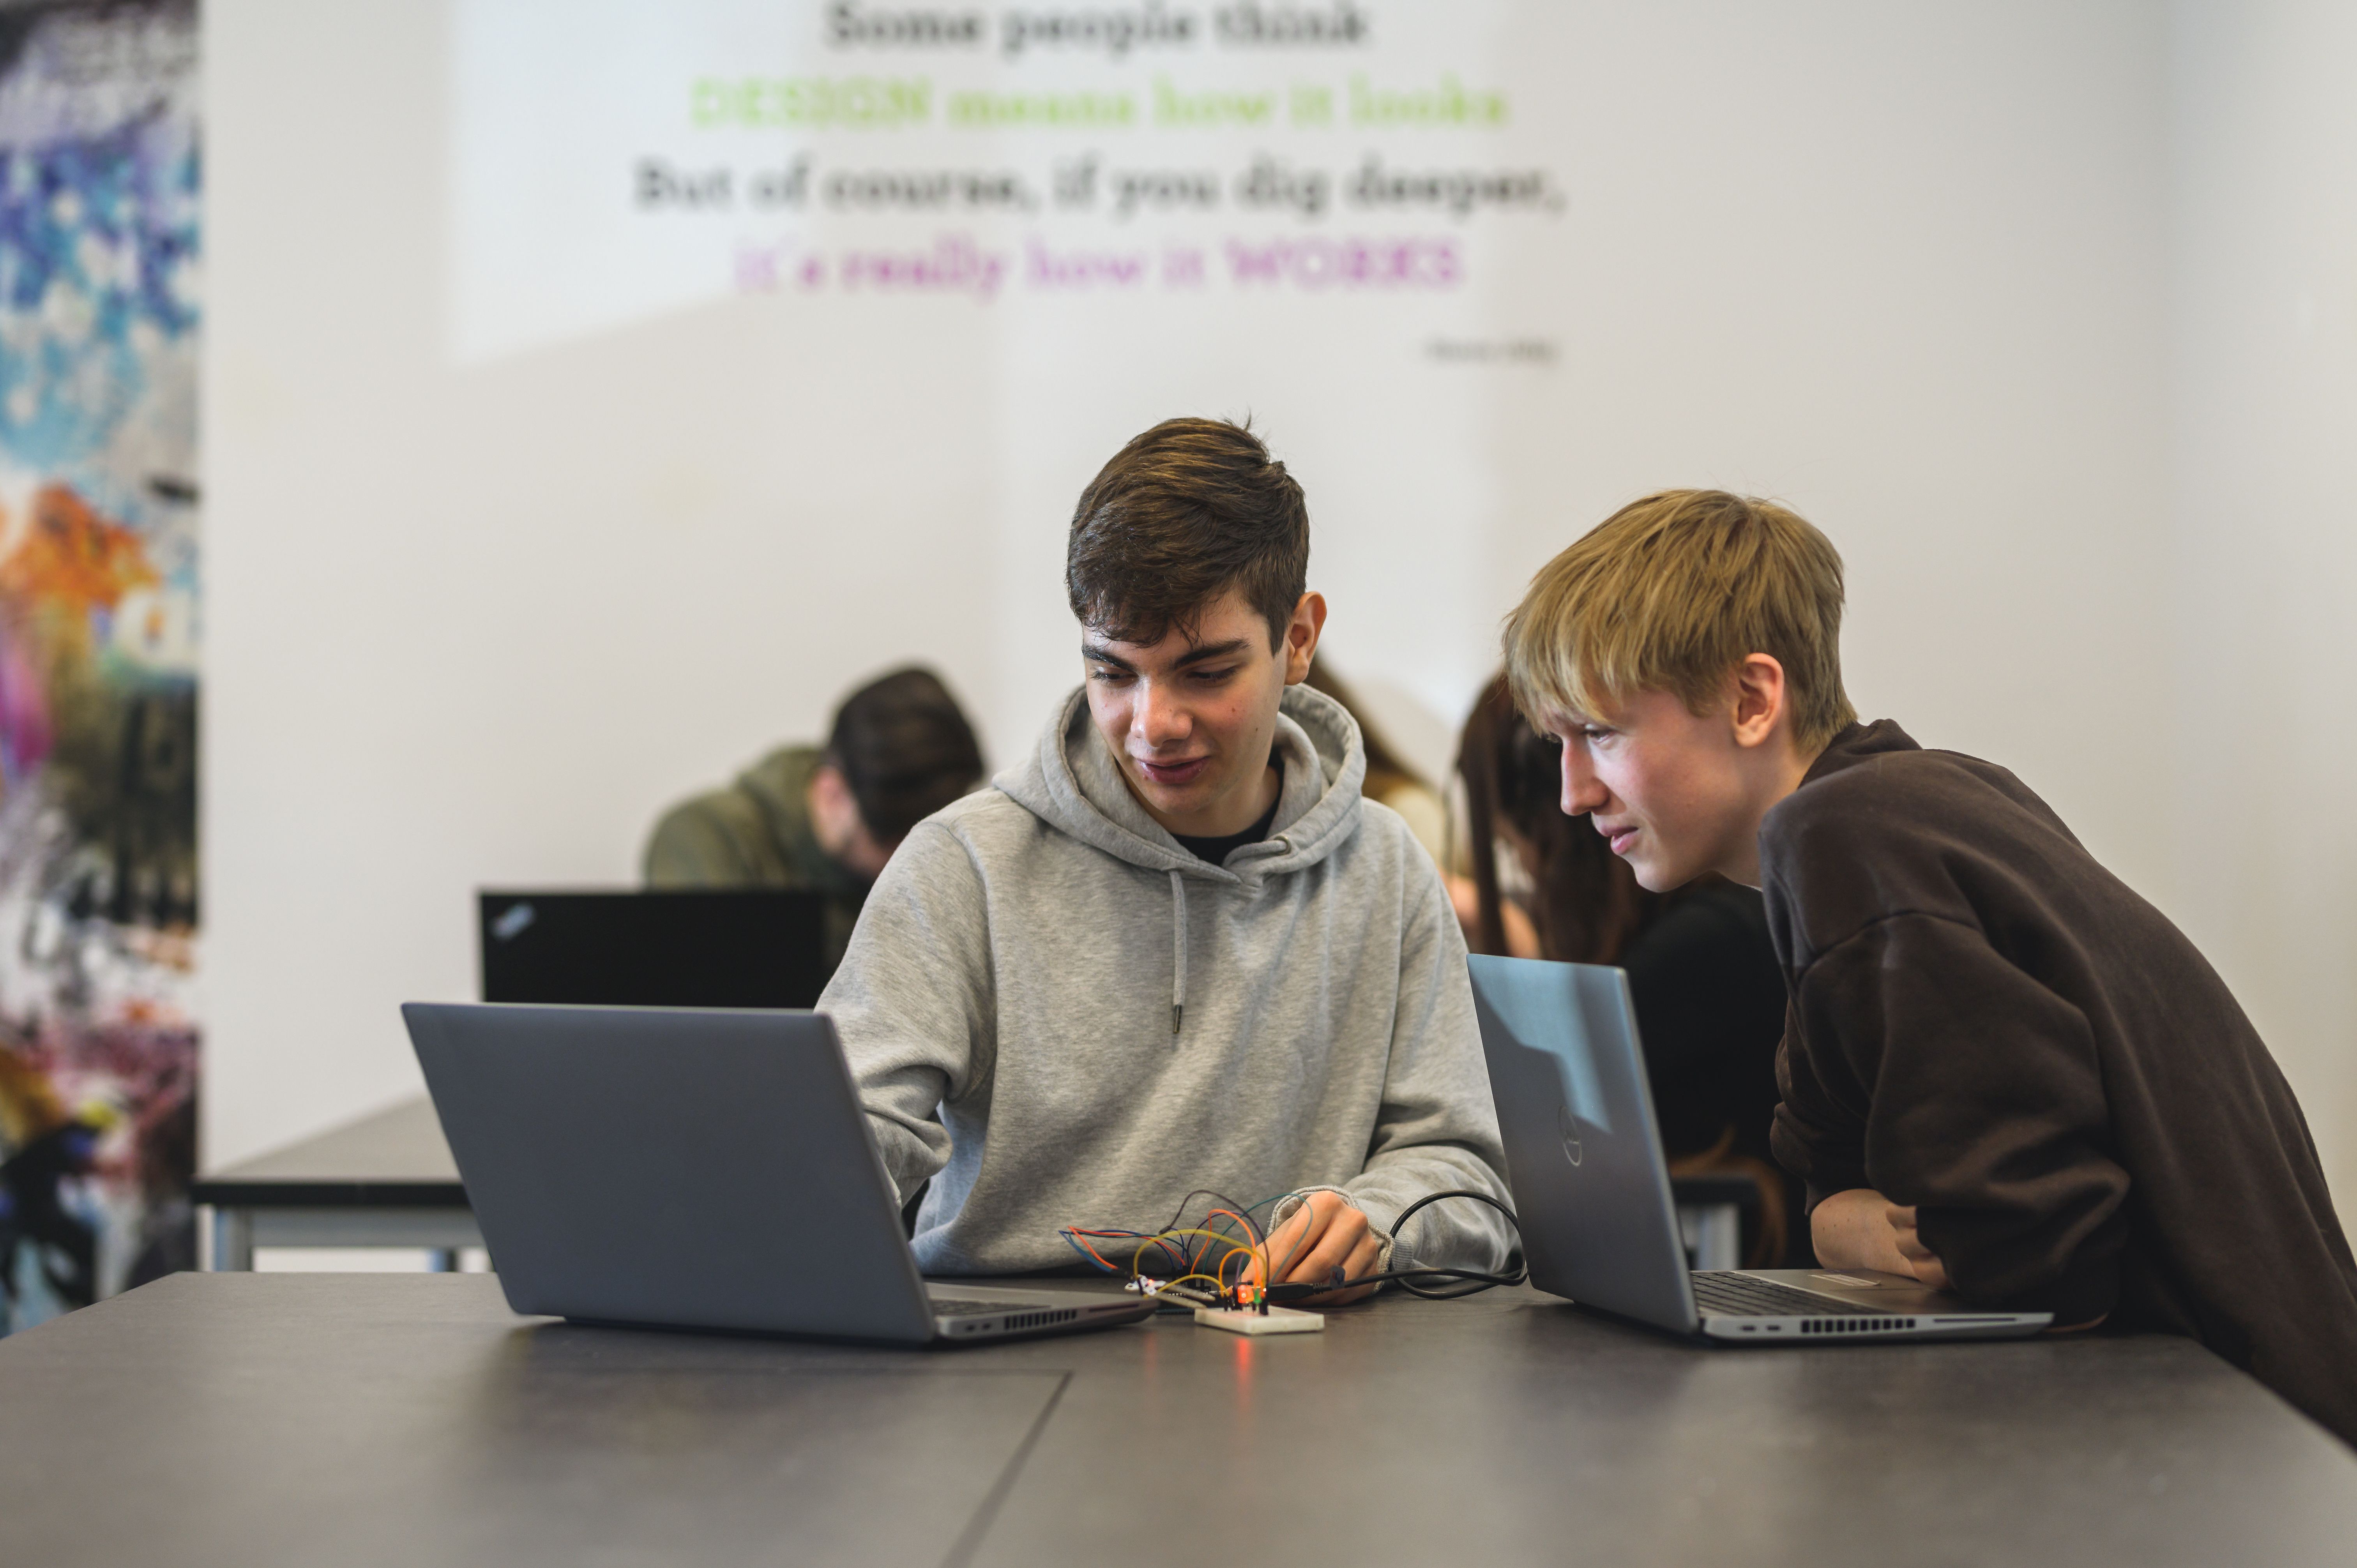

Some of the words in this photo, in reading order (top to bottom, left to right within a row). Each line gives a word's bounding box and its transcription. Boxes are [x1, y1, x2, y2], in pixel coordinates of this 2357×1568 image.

[827, 0, 986, 48] Some
[1000, 0, 1199, 57] people
[1214, 0, 1369, 48] think
[691, 76, 931, 129] DESIGN
[947, 91, 1139, 129] means
[1153, 76, 1275, 127] how
[1290, 76, 1332, 126] it
[1349, 76, 1510, 128] looks
[634, 158, 732, 209] But
[750, 156, 810, 207] of
[823, 170, 1040, 218] course,
[1053, 155, 1098, 207] if
[1111, 171, 1222, 222] you
[1234, 154, 1330, 221] dig
[1344, 156, 1567, 222] deeper,
[839, 234, 1009, 303] really
[1027, 236, 1146, 288] how
[1163, 236, 1204, 285] it
[1224, 236, 1464, 290] WORKS
